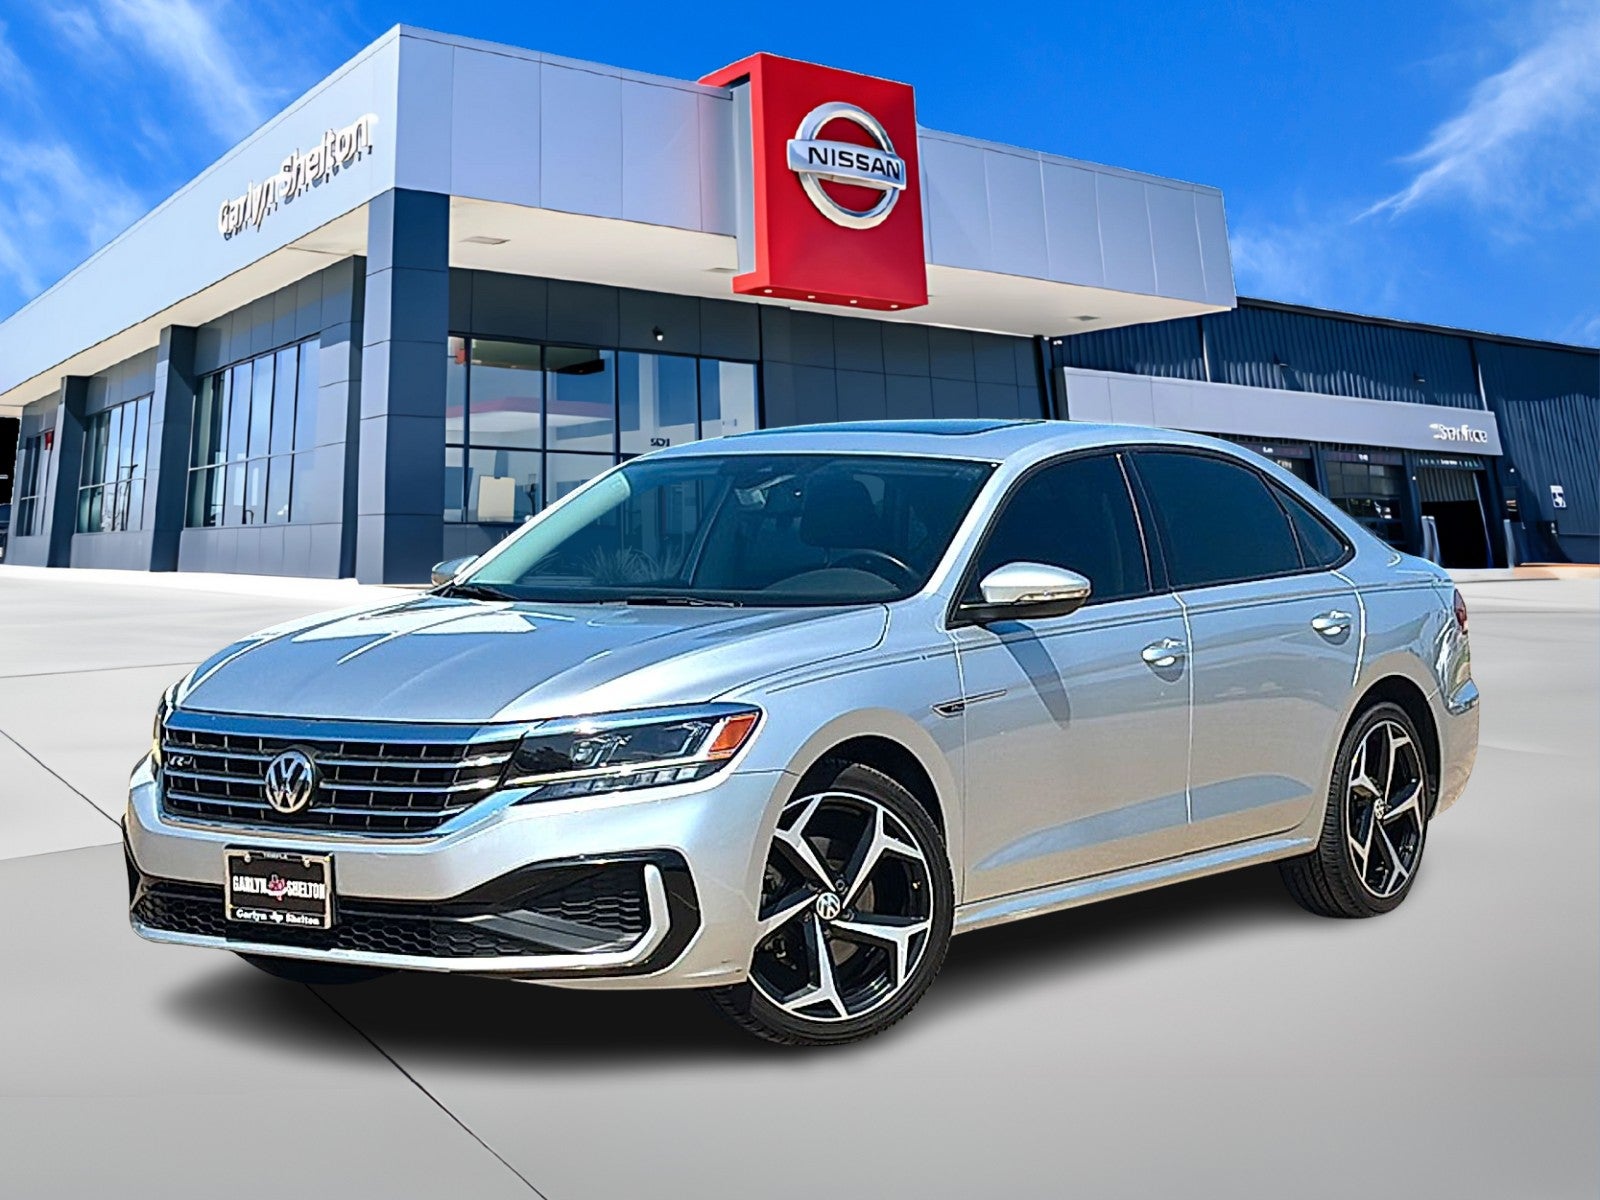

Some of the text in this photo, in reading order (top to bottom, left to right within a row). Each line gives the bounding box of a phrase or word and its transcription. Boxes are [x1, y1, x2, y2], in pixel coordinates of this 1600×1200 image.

[279, 118, 371, 203] Shelton
[808, 146, 901, 180] NISSAN
[286, 880, 326, 900] SHELTON
